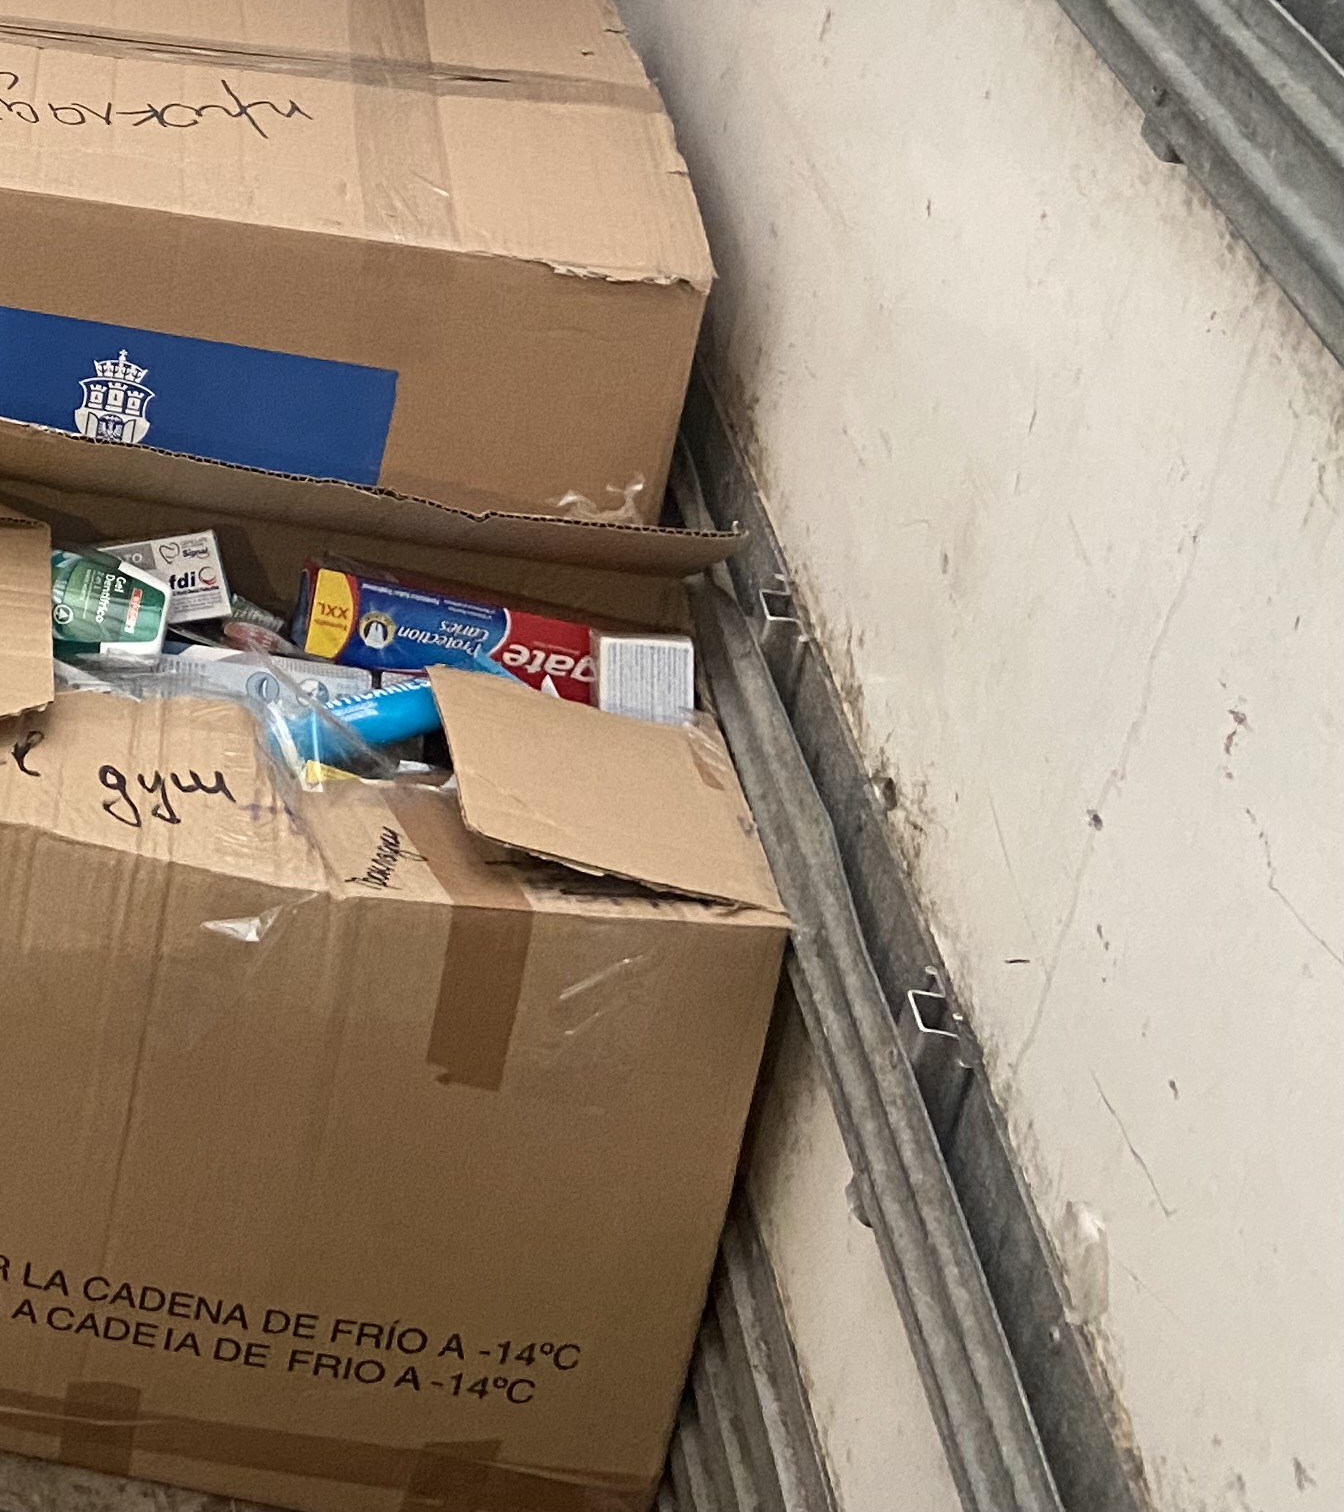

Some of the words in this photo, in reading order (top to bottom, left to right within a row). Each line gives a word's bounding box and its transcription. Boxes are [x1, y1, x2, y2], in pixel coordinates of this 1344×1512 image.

[114, 576, 127, 594] Gel
[168, 571, 197, 590] fdi
[317, 600, 350, 619] XXL
[397, 625, 483, 659] Protection
[22, 1260, 70, 1296] LA
[82, 1274, 250, 1331] CADENA
[262, 1308, 319, 1341] DE
[330, 1315, 428, 1357] FRÍO
[438, 1333, 467, 1361] A
[12, 1298, 39, 1325] A
[46, 1306, 202, 1358] CADEIA
[212, 1337, 268, 1369] DE
[288, 1348, 386, 1385] FRIO
[394, 1366, 422, 1392] A
